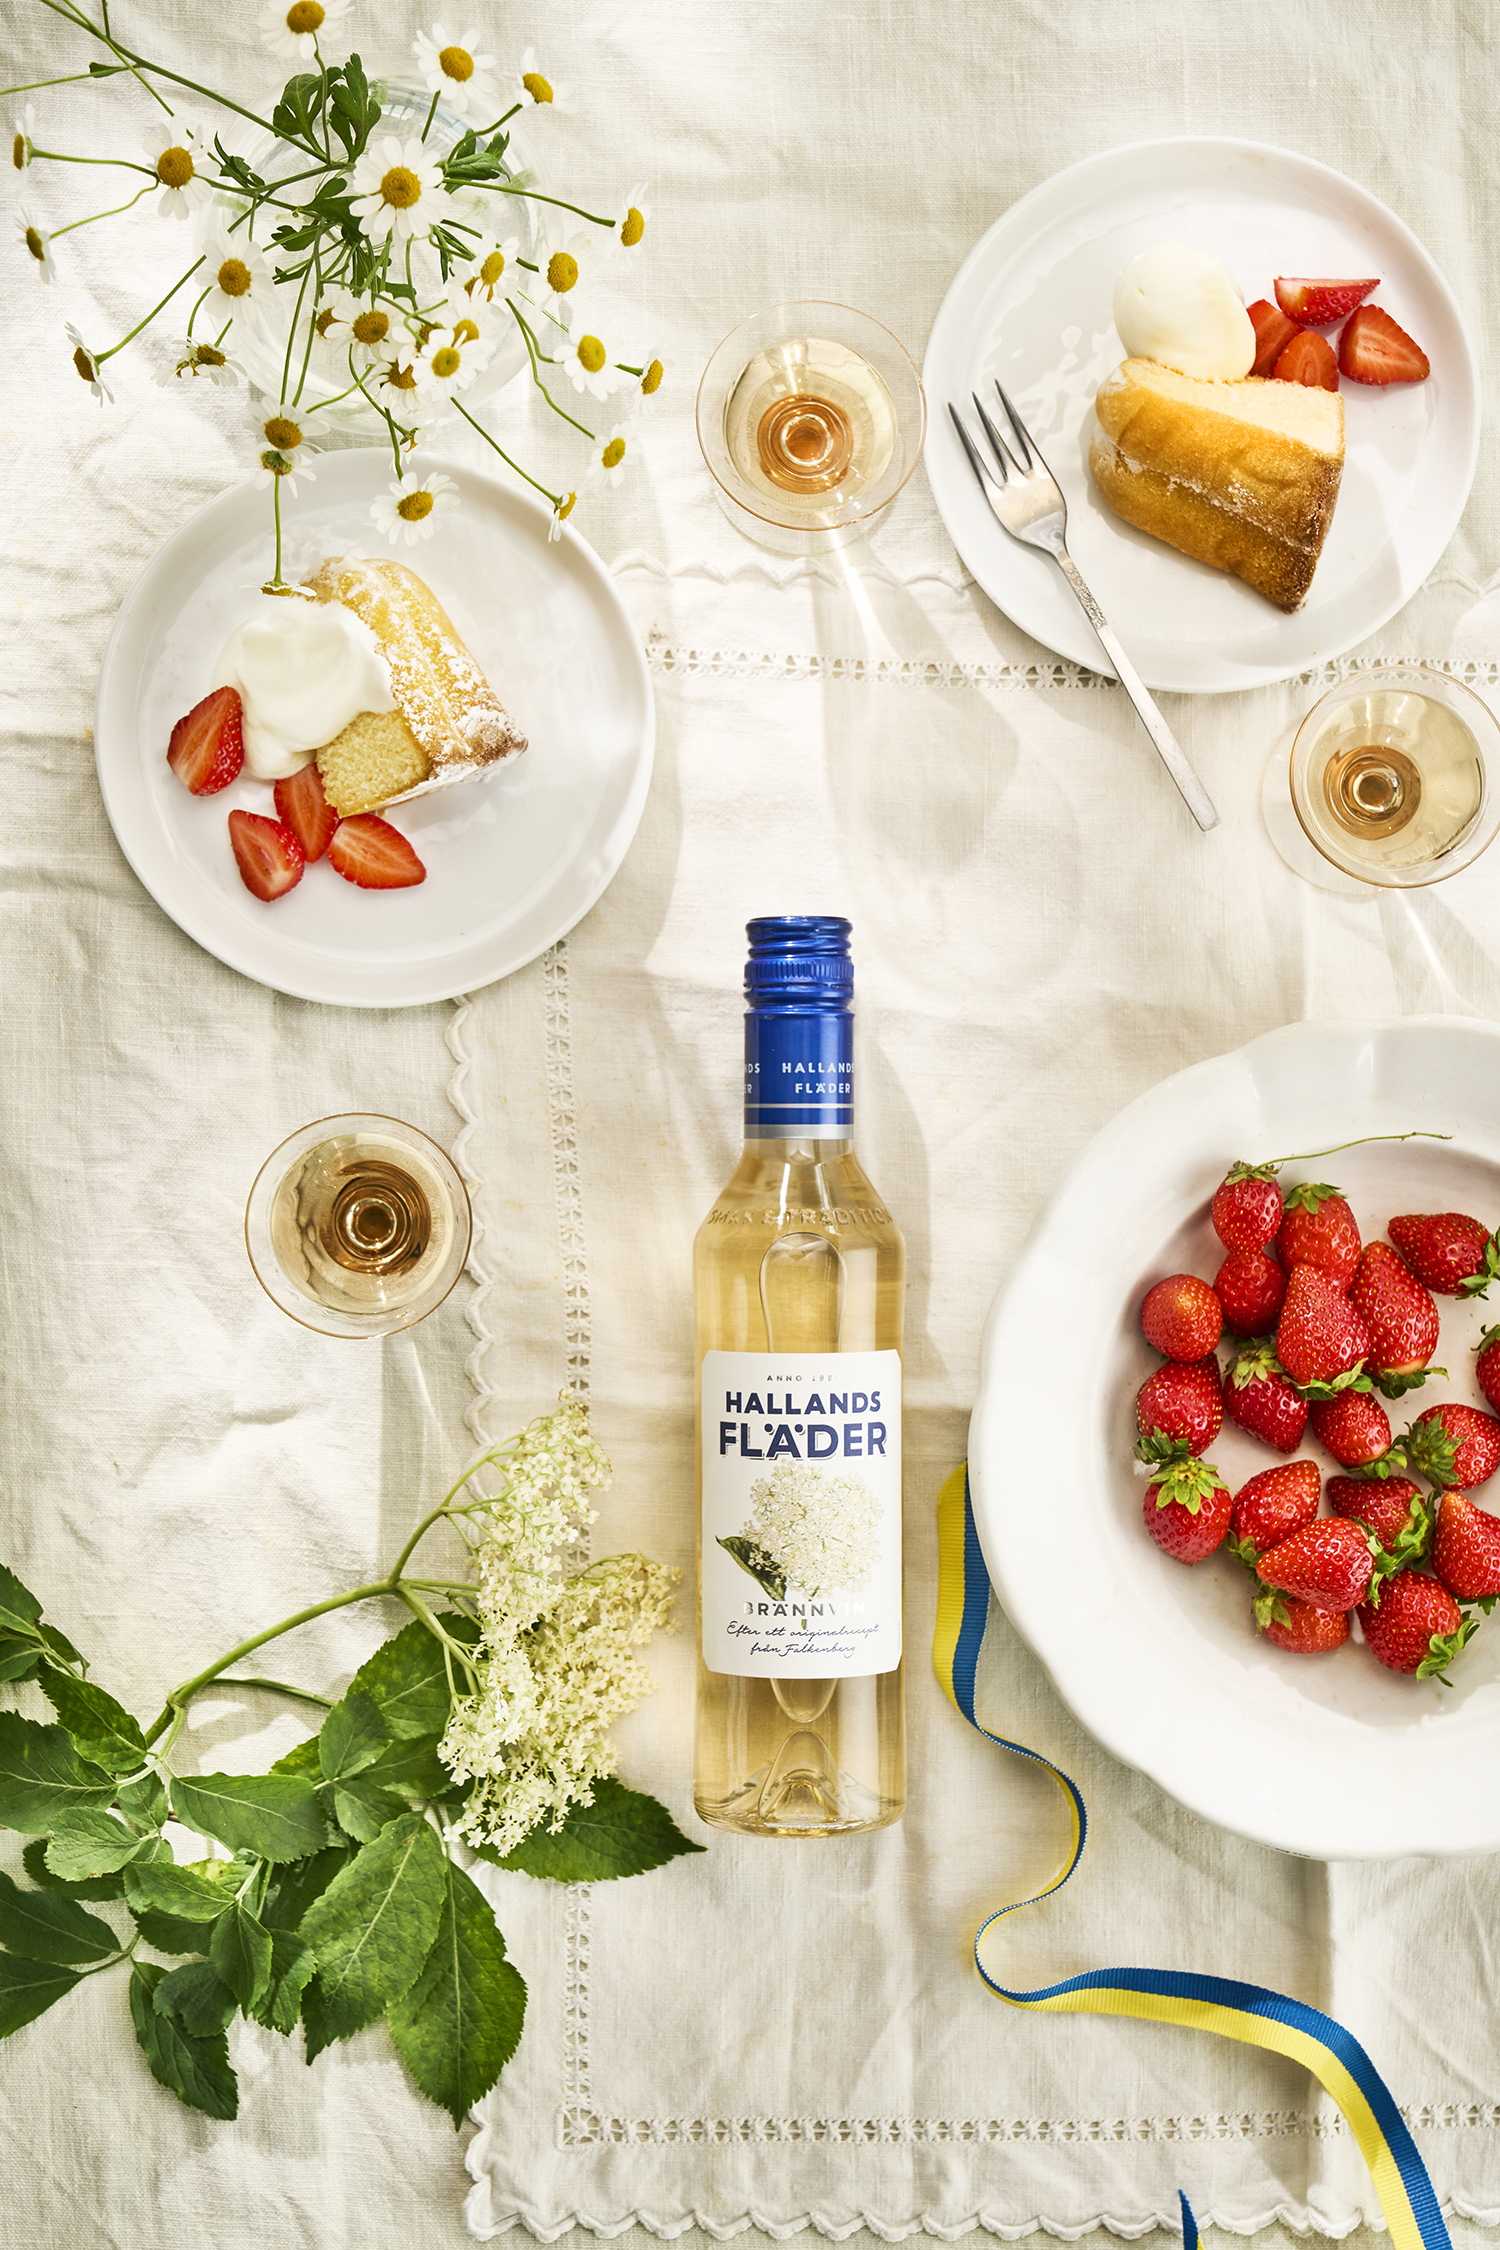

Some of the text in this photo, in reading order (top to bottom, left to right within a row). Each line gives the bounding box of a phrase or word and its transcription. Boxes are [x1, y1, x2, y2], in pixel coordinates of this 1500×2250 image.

[781, 1062, 854, 1074] HALLANDS
[795, 1082, 851, 1094] FLÄDER
[708, 1209, 756, 1225] SMAK
[766, 1374, 803, 1382] ANNO
[725, 1391, 881, 1415] HALLANDS
[719, 1421, 887, 1460] FLÄDER
[743, 1601, 865, 1617] BRÄNNVIN
[726, 1620, 761, 1638] Efter
[765, 1626, 786, 1637] ett
[789, 1623, 880, 1643] originalrecept
[750, 1641, 856, 1659] från Falkenberg
